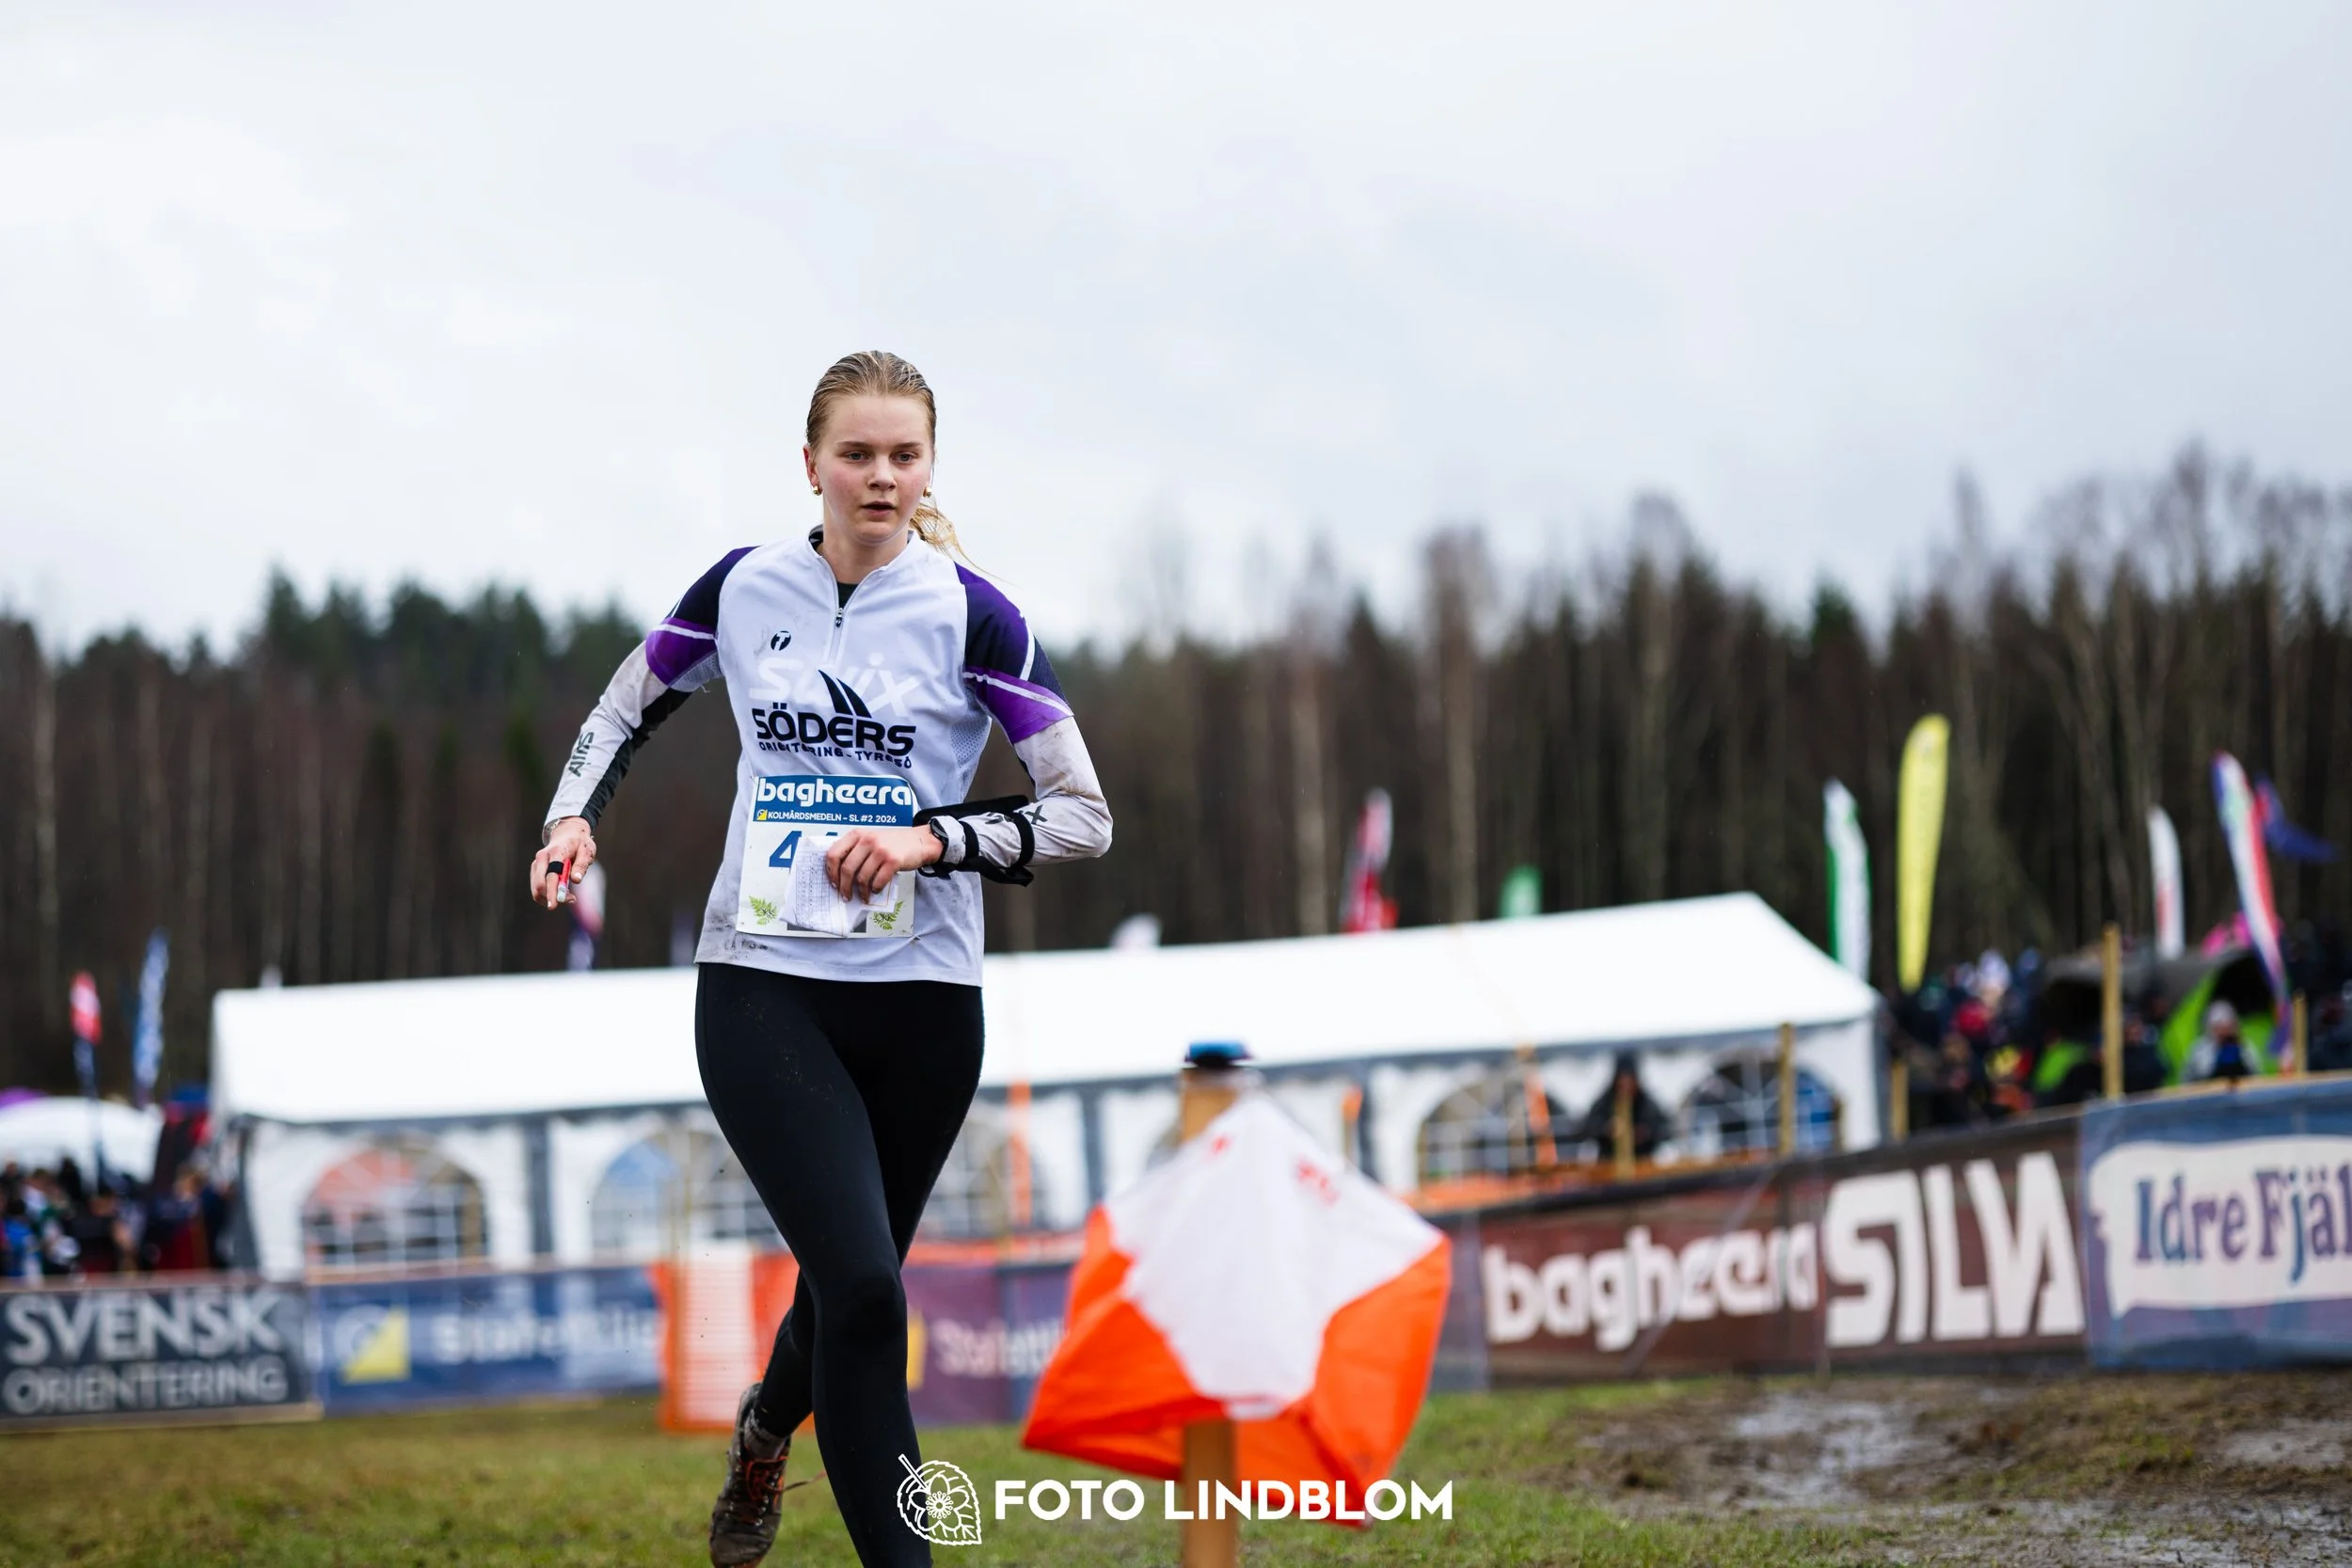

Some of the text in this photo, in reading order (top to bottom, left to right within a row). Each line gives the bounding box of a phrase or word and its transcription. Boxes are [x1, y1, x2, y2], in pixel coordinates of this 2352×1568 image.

[752, 702, 916, 756] SÖDERS
[757, 778, 912, 807] bagheera
[768, 810, 841, 822] KOLMÅRDSMEDELN
[849, 815, 860, 823] SL
[861, 815, 873, 823] #2
[876, 815, 897, 823] 2026
[1822, 1150, 2086, 1347] SILVA
[2137, 1174, 2247, 1260] Idre
[1484, 1225, 1819, 1353] bagheera
[5, 1287, 282, 1365] SVENSK
[3, 1354, 289, 1415] ORIENTERING
